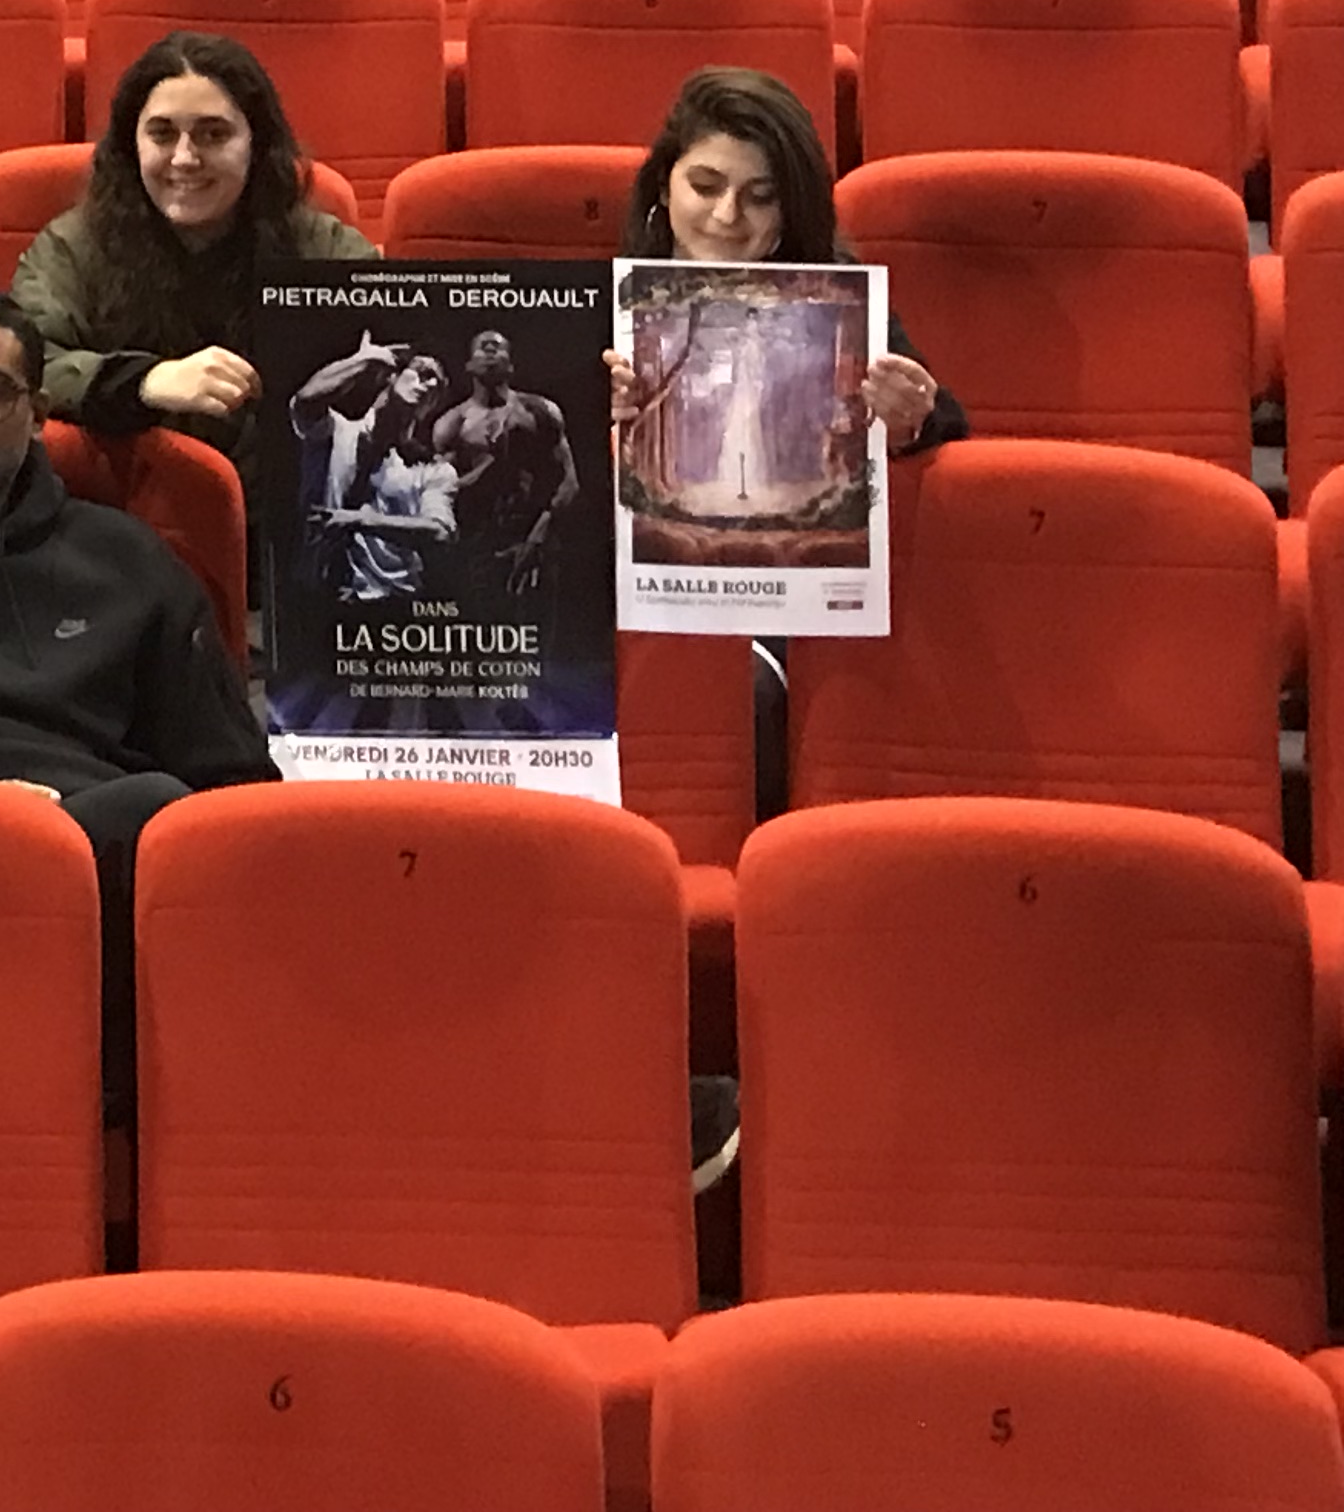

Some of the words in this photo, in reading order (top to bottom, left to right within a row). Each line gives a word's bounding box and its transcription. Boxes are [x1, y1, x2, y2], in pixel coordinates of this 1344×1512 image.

[584, 197, 599, 219] 8
[1032, 200, 1047, 223] 7
[262, 286, 429, 307] PIETRAGALLA
[449, 287, 599, 308] DEROUAULT
[1030, 508, 1045, 532] 7
[636, 577, 659, 591] LA
[662, 579, 718, 594] SALLE
[723, 581, 787, 595] ROUGE
[413, 601, 459, 616] DANS
[336, 624, 374, 652] LA
[381, 624, 539, 655] SOLITUDE
[336, 659, 369, 676] DES
[374, 659, 444, 676] CHAMPS
[450, 660, 473, 676] DE
[478, 661, 541, 677] COTON
[350, 683, 366, 697] DE
[370, 683, 474, 698] BERNARD-MARIE
[288, 745, 388, 763] VENDREDI
[395, 747, 419, 764] 26
[425, 748, 511, 766] JANVIER
[528, 750, 593, 767] 20H30
[452, 771, 516, 787] ROUGE
[399, 849, 418, 877] 7
[1017, 876, 1038, 904] 6
[267, 1375, 293, 1412] 6
[990, 1407, 1014, 1445] 5
